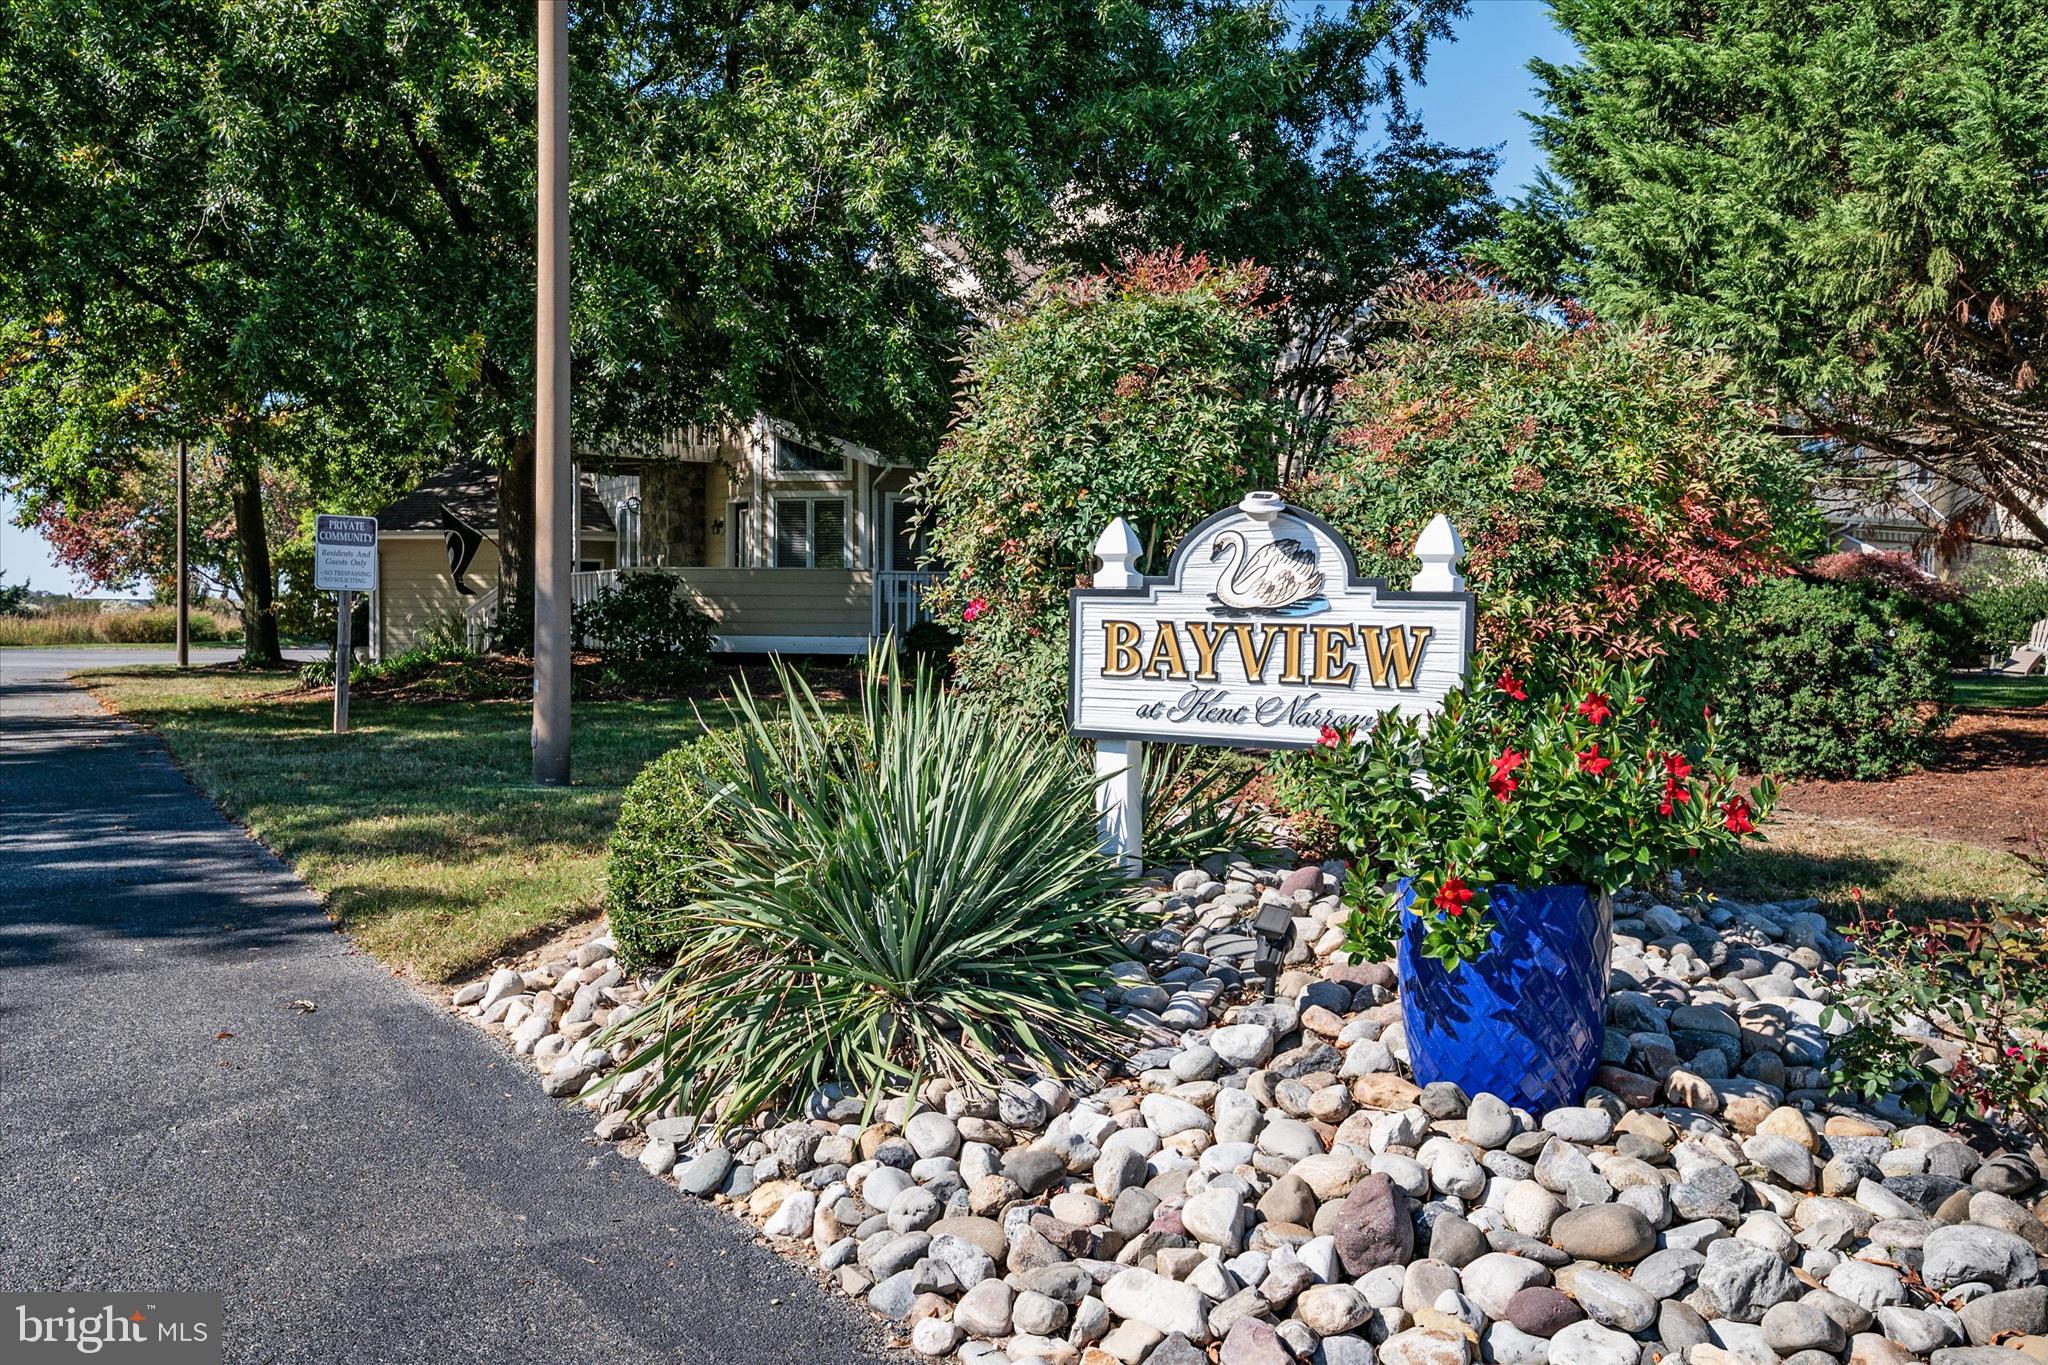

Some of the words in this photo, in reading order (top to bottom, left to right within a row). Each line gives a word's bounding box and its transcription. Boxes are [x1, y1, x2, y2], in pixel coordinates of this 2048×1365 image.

[329, 520, 365, 531] PRIVATE
[319, 531, 374, 543] COMMUNITY
[321, 549, 354, 558] Residents
[356, 550, 371, 558] And
[325, 558, 348, 566] Guests
[350, 559, 367, 568] Only
[1101, 619, 1434, 690] BAYVIEW
[1136, 701, 1163, 718] at
[1167, 684, 1248, 723] Kent
[1255, 692, 1377, 728] Narrow
